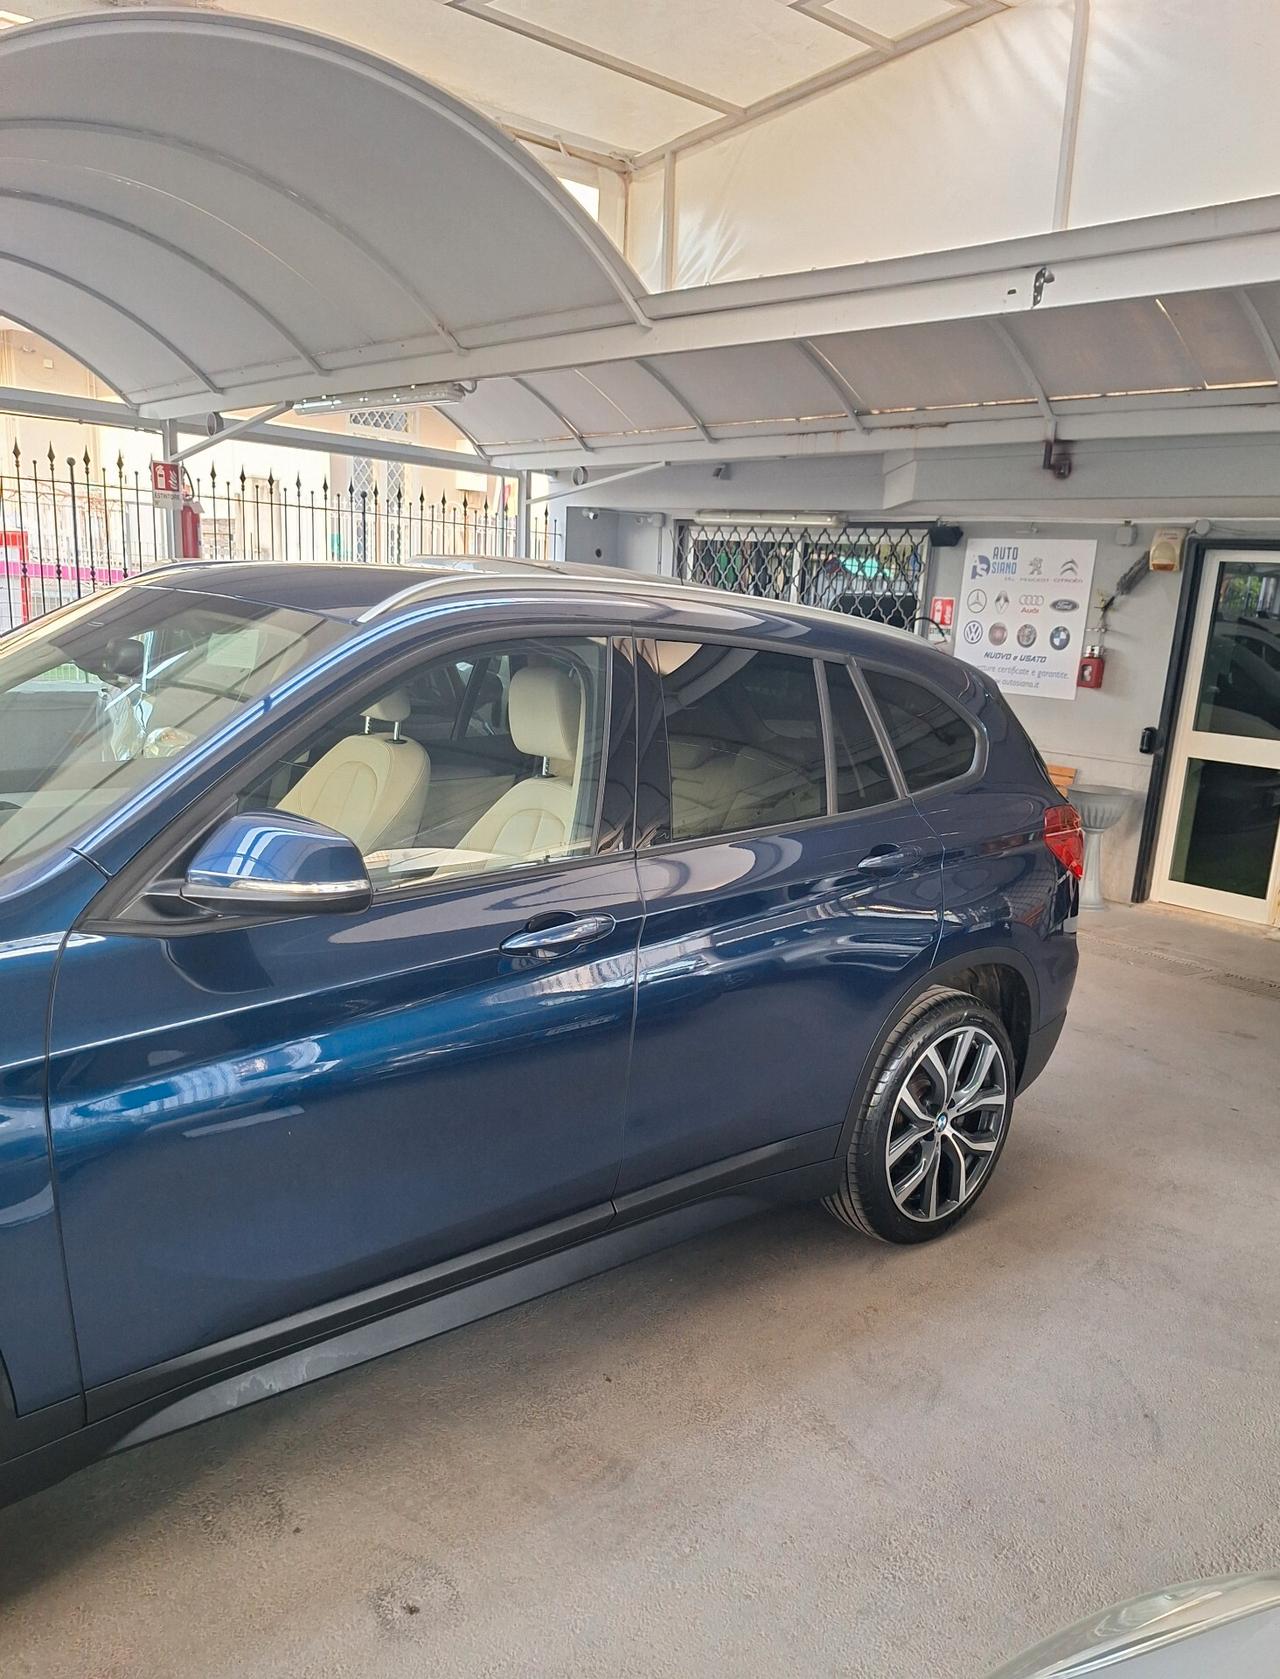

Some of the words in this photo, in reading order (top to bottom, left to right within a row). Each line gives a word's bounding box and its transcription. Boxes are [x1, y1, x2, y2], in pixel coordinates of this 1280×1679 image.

[993, 546, 1019, 560] AUTO
[991, 561, 1017, 575] SIANO
[984, 651, 1012, 660] NUOVO
[1019, 654, 1047, 663] USATO
